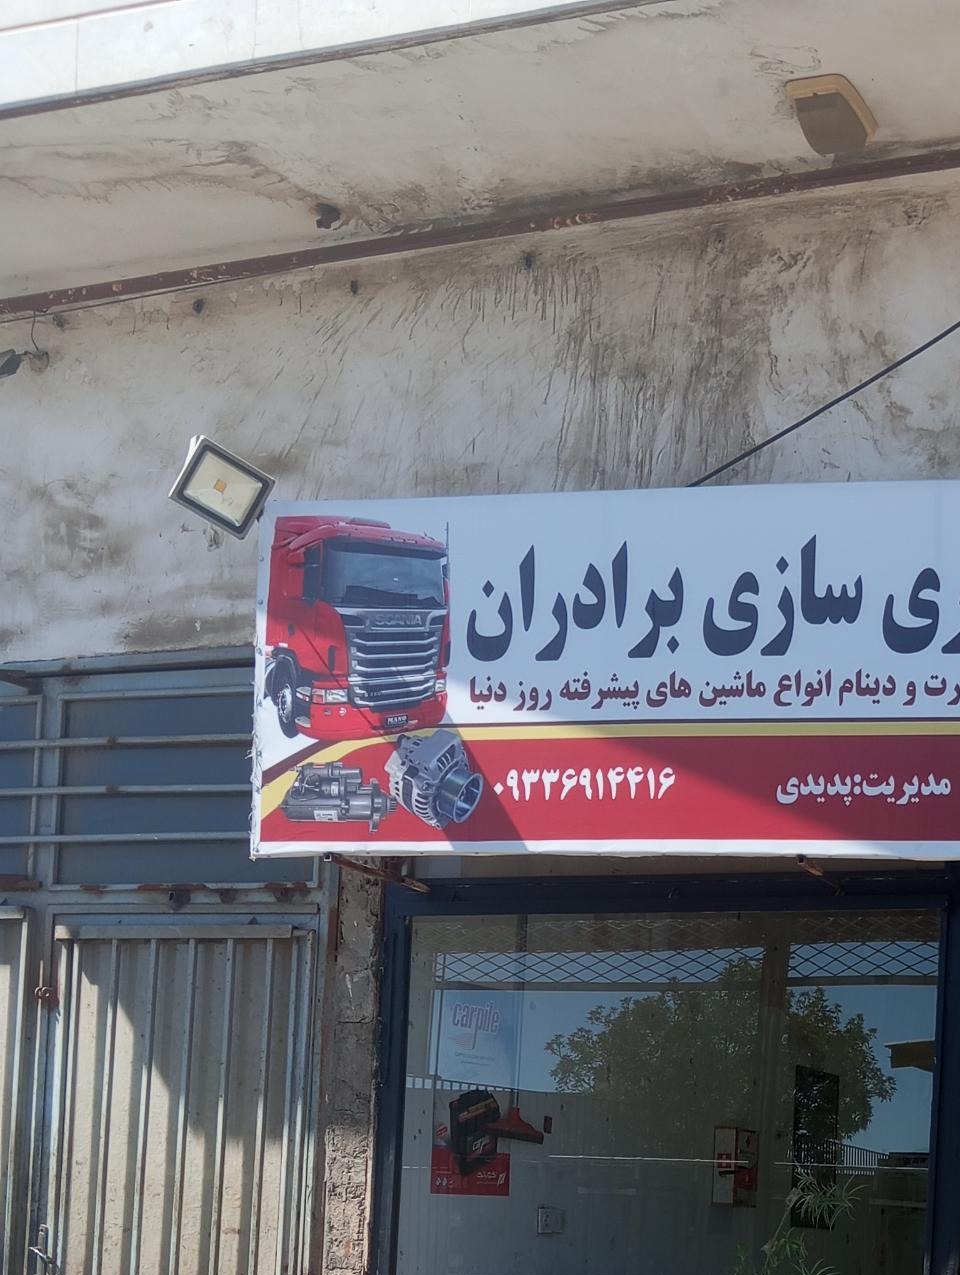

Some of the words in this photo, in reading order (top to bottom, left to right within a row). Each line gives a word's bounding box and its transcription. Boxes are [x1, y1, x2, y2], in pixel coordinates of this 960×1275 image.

[466, 540, 684, 662] برادران
[703, 534, 863, 658] سازی
[375, 614, 422, 626] SCANIA
[469, 675, 508, 711] دنیا
[513, 680, 553, 711] روز
[559, 671, 640, 711] پیشرفته
[646, 671, 692, 709] های
[698, 669, 766, 708] ماشین
[773, 668, 832, 707] انواع
[838, 667, 896, 707] دینام
[902, 680, 917, 706] و
[493, 766, 676, 801] ۰۹۳۳۶۹۱۴۴۱۶
[452, 1000, 500, 1050] carpile
